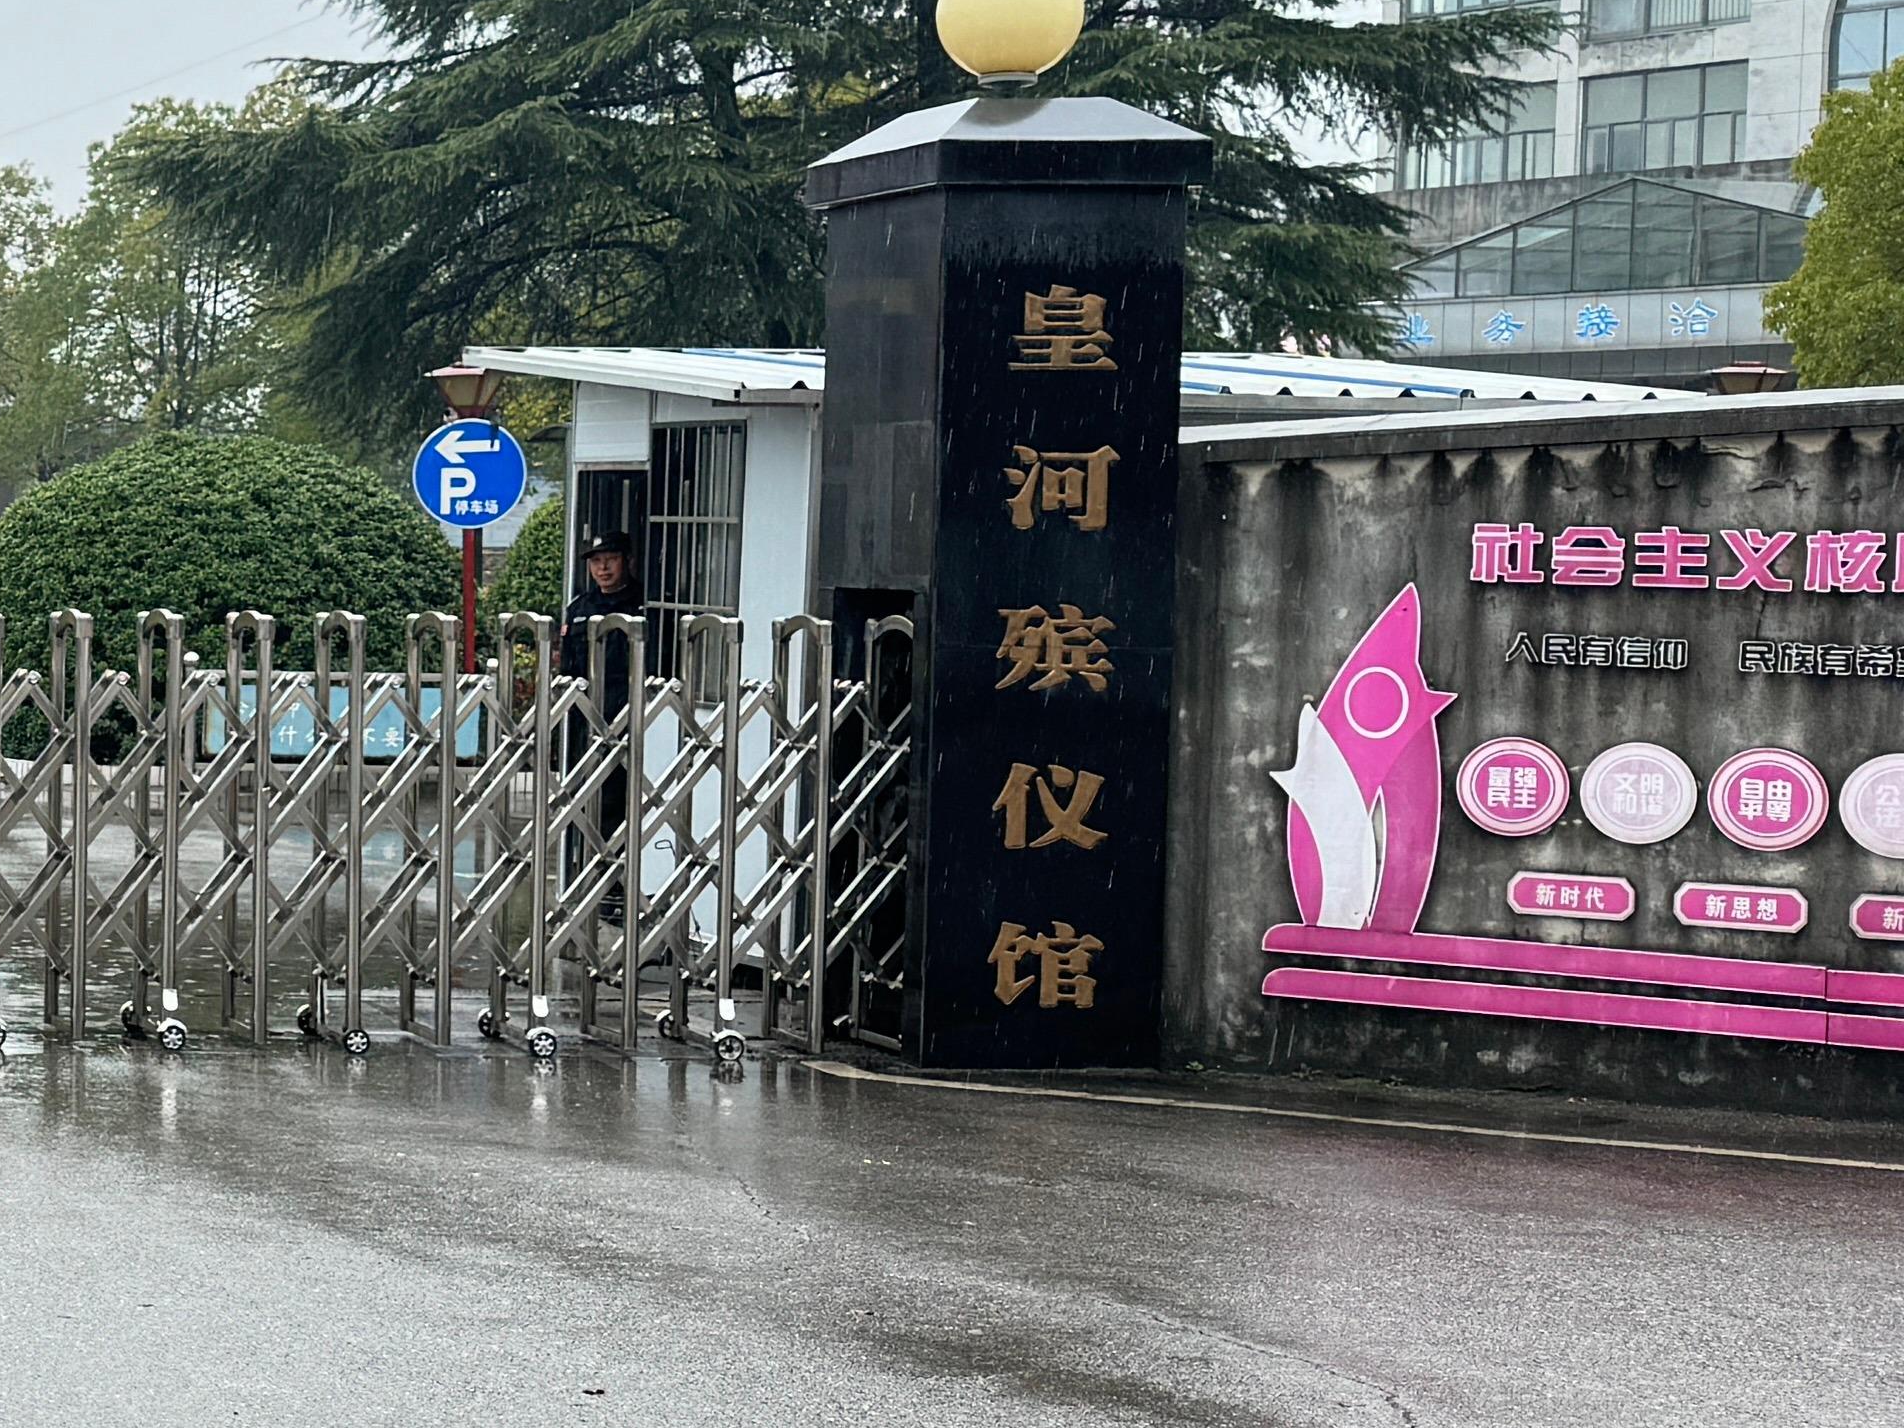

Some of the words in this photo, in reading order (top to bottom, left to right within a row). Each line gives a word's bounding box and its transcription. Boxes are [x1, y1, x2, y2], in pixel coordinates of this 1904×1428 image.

[440, 467, 476, 515] P
[454, 499, 499, 516] 停车场
[1469, 522, 1904, 593] 社会主义核
[987, 284, 1121, 1009] 皇河殡仪馆
[1505, 631, 1689, 671] 人民有信仰
[1739, 641, 1904, 677] 民族有希
[1488, 766, 1537, 789] 富强
[1613, 773, 1664, 794] 文明
[1487, 787, 1536, 809] 民主
[1739, 778, 1792, 801] 自由
[1613, 794, 1664, 816] 和谐
[1738, 799, 1791, 822] 平等
[1535, 883, 1605, 910] 新时代
[1705, 894, 1778, 921] 新思想
